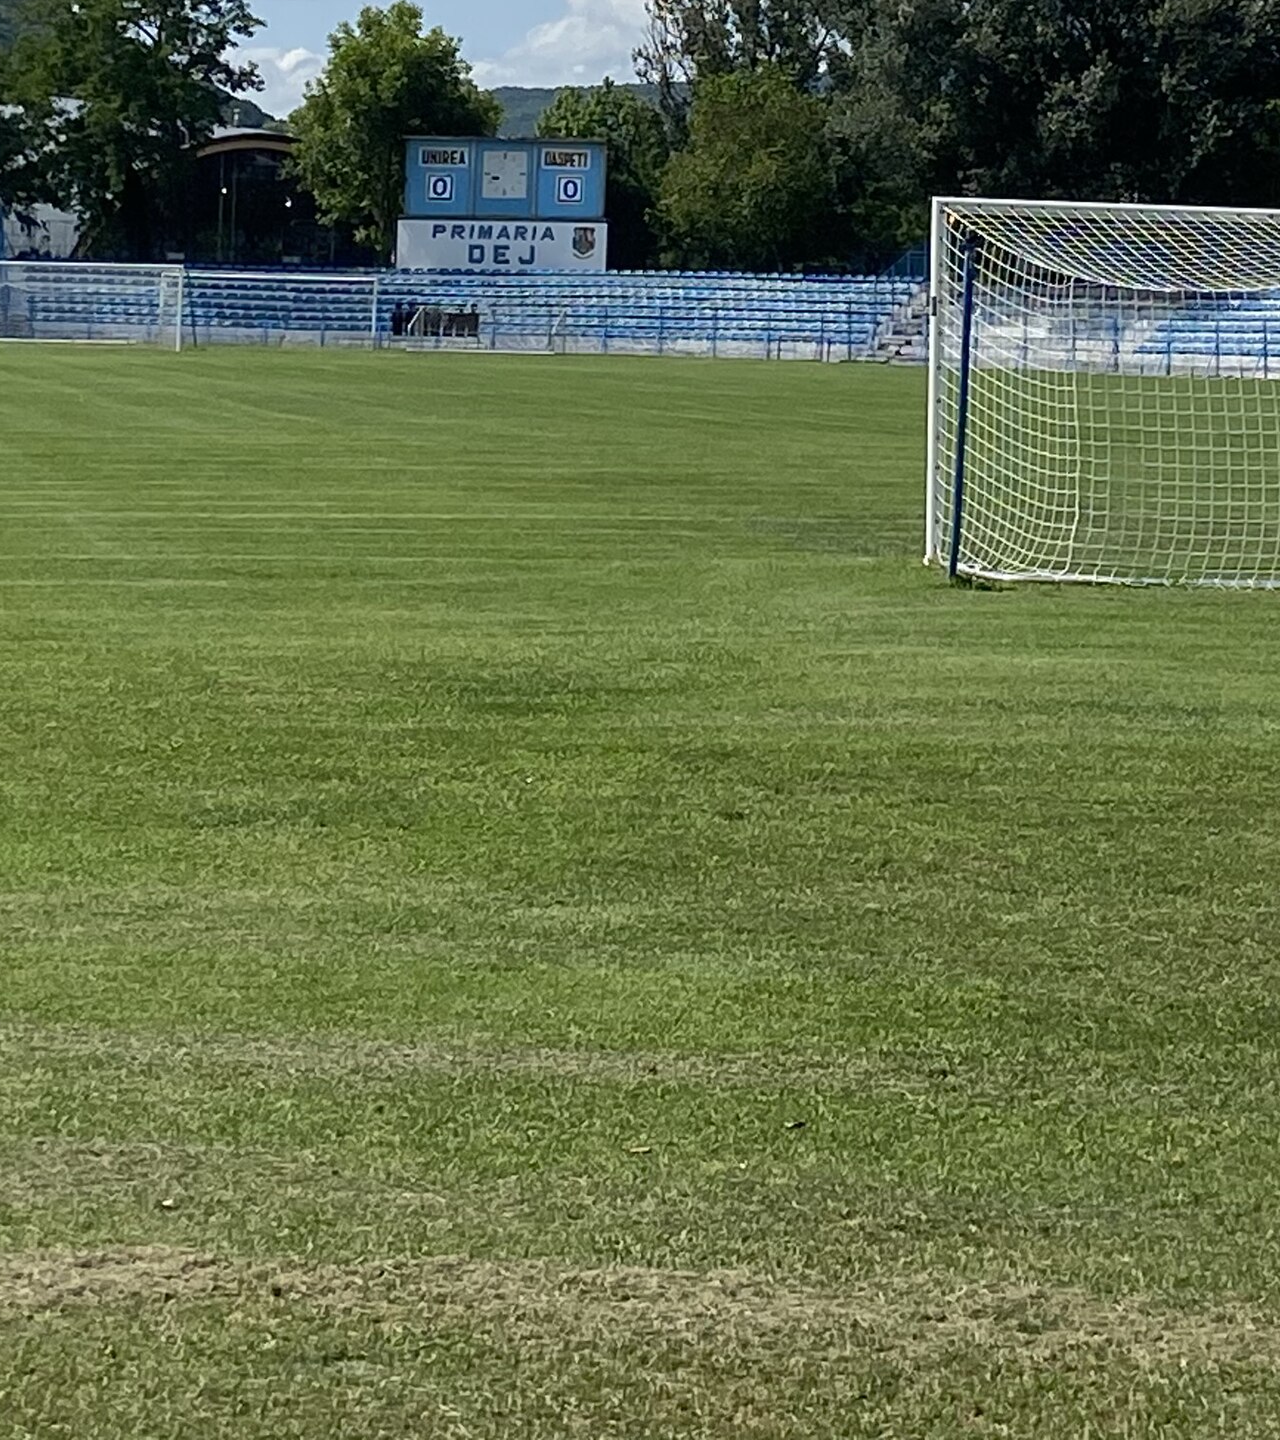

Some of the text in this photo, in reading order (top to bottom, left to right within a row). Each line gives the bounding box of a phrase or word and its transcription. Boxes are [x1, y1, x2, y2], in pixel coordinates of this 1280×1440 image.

[421, 149, 467, 165] UNIREA
[432, 177, 448, 197] 0
[563, 179, 578, 199] 0
[432, 224, 555, 241] PRIMARIA
[468, 244, 536, 265] DEJ
